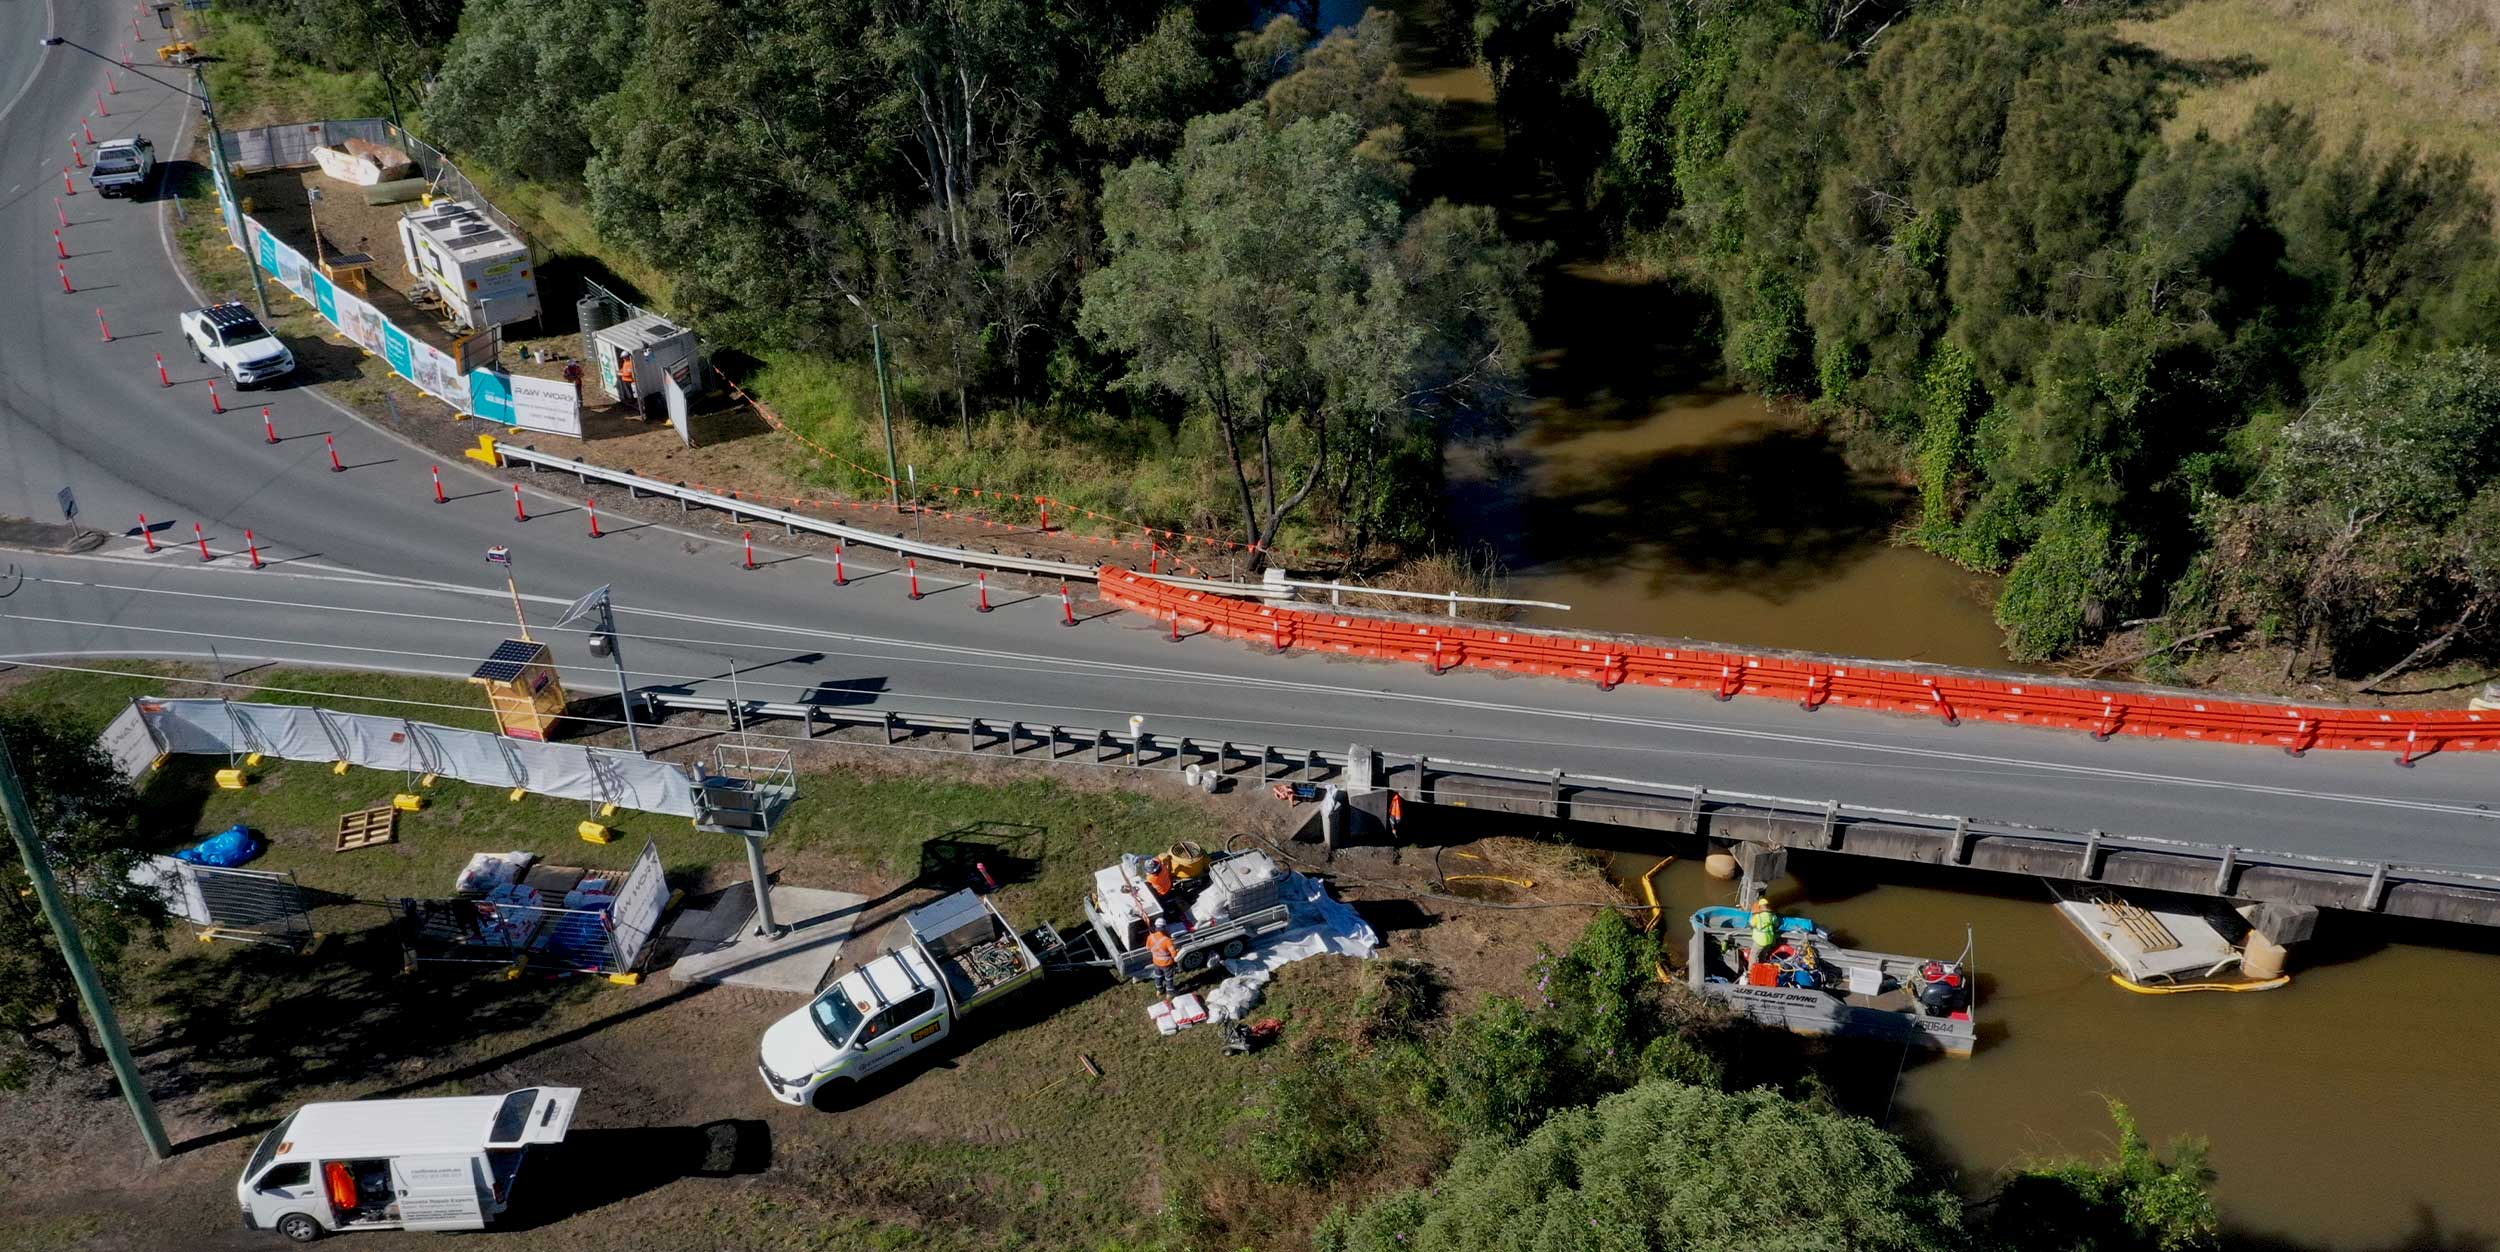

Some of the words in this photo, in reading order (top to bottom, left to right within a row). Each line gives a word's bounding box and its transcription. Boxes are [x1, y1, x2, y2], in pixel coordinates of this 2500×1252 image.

[514, 386, 539, 397] RAW
[543, 390, 574, 402] WORX
[1754, 990, 1785, 1000] COAST
[1786, 994, 1818, 1004] DIVING
